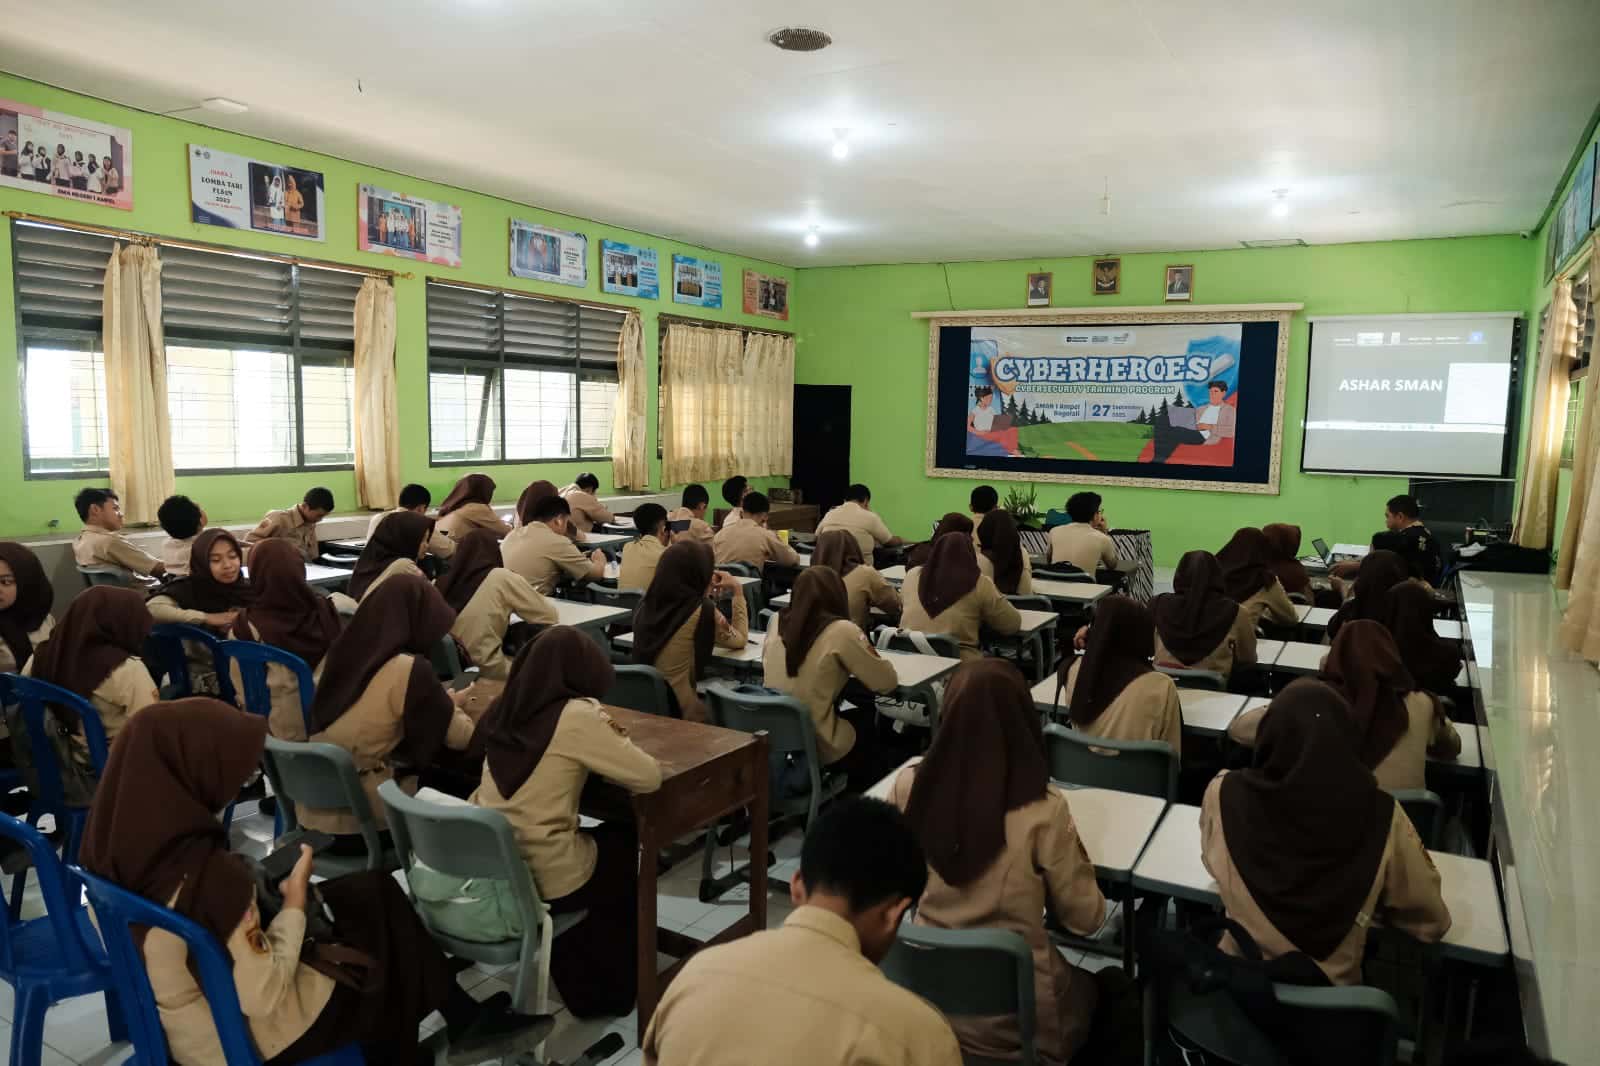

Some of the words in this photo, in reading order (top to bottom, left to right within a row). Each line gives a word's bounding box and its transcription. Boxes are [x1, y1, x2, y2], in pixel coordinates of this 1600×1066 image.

[201, 176, 226, 187] LOMBA
[227, 181, 243, 191] TARI
[996, 356, 1212, 382] CYBERHEROES
[1015, 384, 1085, 394] CYBERSECURITY
[1086, 384, 1128, 394] TRAINING
[1128, 384, 1176, 395] PROGRAM
[1338, 379, 1391, 392] ASHAR
[1394, 379, 1444, 393] SMAN
[1092, 404, 1111, 417] 27
